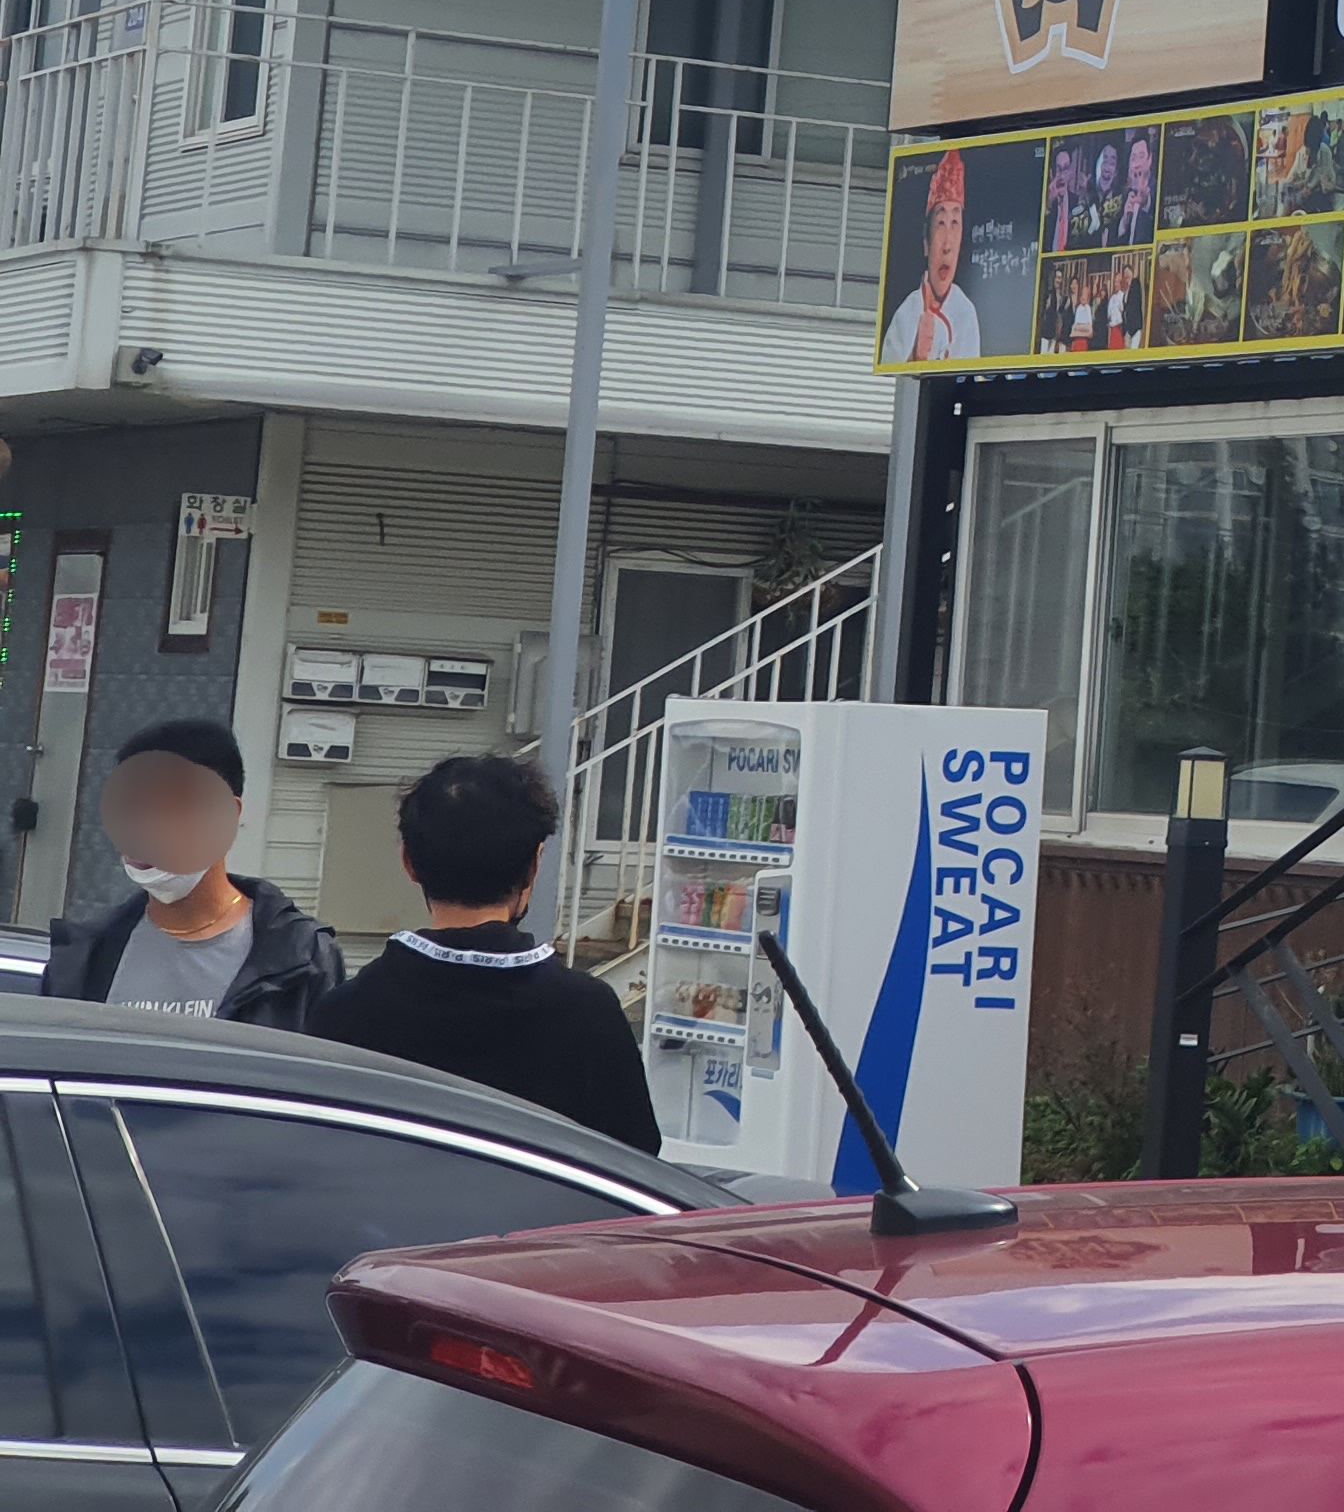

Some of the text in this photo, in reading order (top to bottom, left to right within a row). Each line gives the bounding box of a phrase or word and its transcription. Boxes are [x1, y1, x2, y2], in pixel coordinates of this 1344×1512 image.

[186, 494, 248, 514] 화장실
[727, 746, 779, 774] POCARI
[930, 747, 986, 988] SWEAT
[973, 751, 1030, 1010] POCARI
